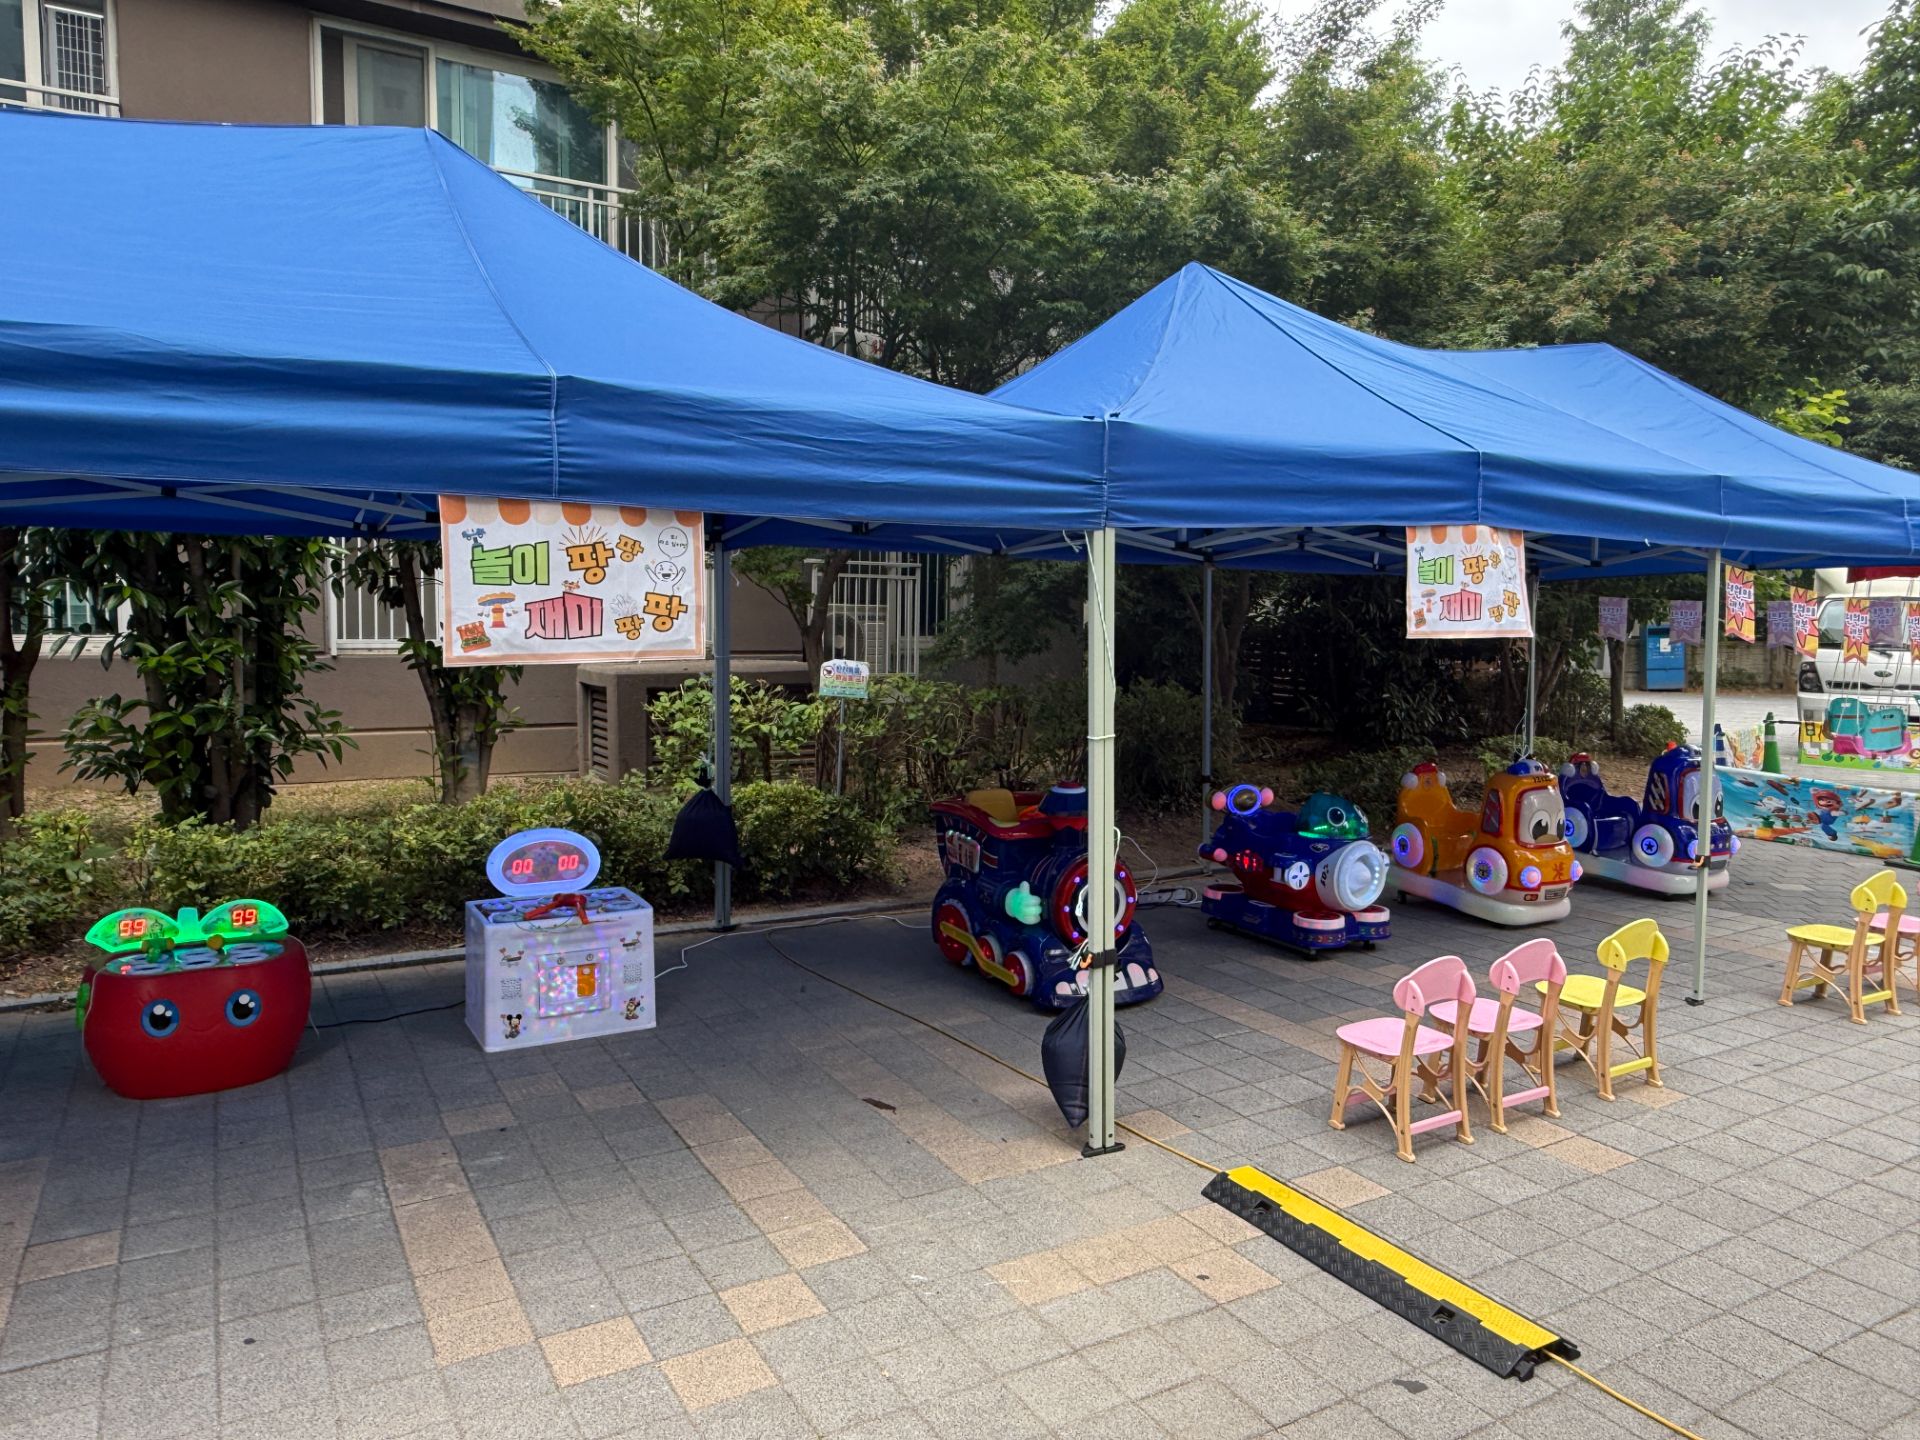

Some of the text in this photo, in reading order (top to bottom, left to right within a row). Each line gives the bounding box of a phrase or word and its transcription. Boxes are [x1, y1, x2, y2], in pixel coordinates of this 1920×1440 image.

[471, 534, 645, 586] 놀이 팡 팡
[1418, 554, 1454, 585] 놀이
[1462, 554, 1489, 585] 팡
[524, 591, 688, 641] 재미 팡 팡
[1439, 588, 1482, 622] 재미
[512, 858, 533, 875] 00
[558, 855, 579, 871] 00
[119, 919, 146, 937] 99
[232, 908, 257, 926] 99
